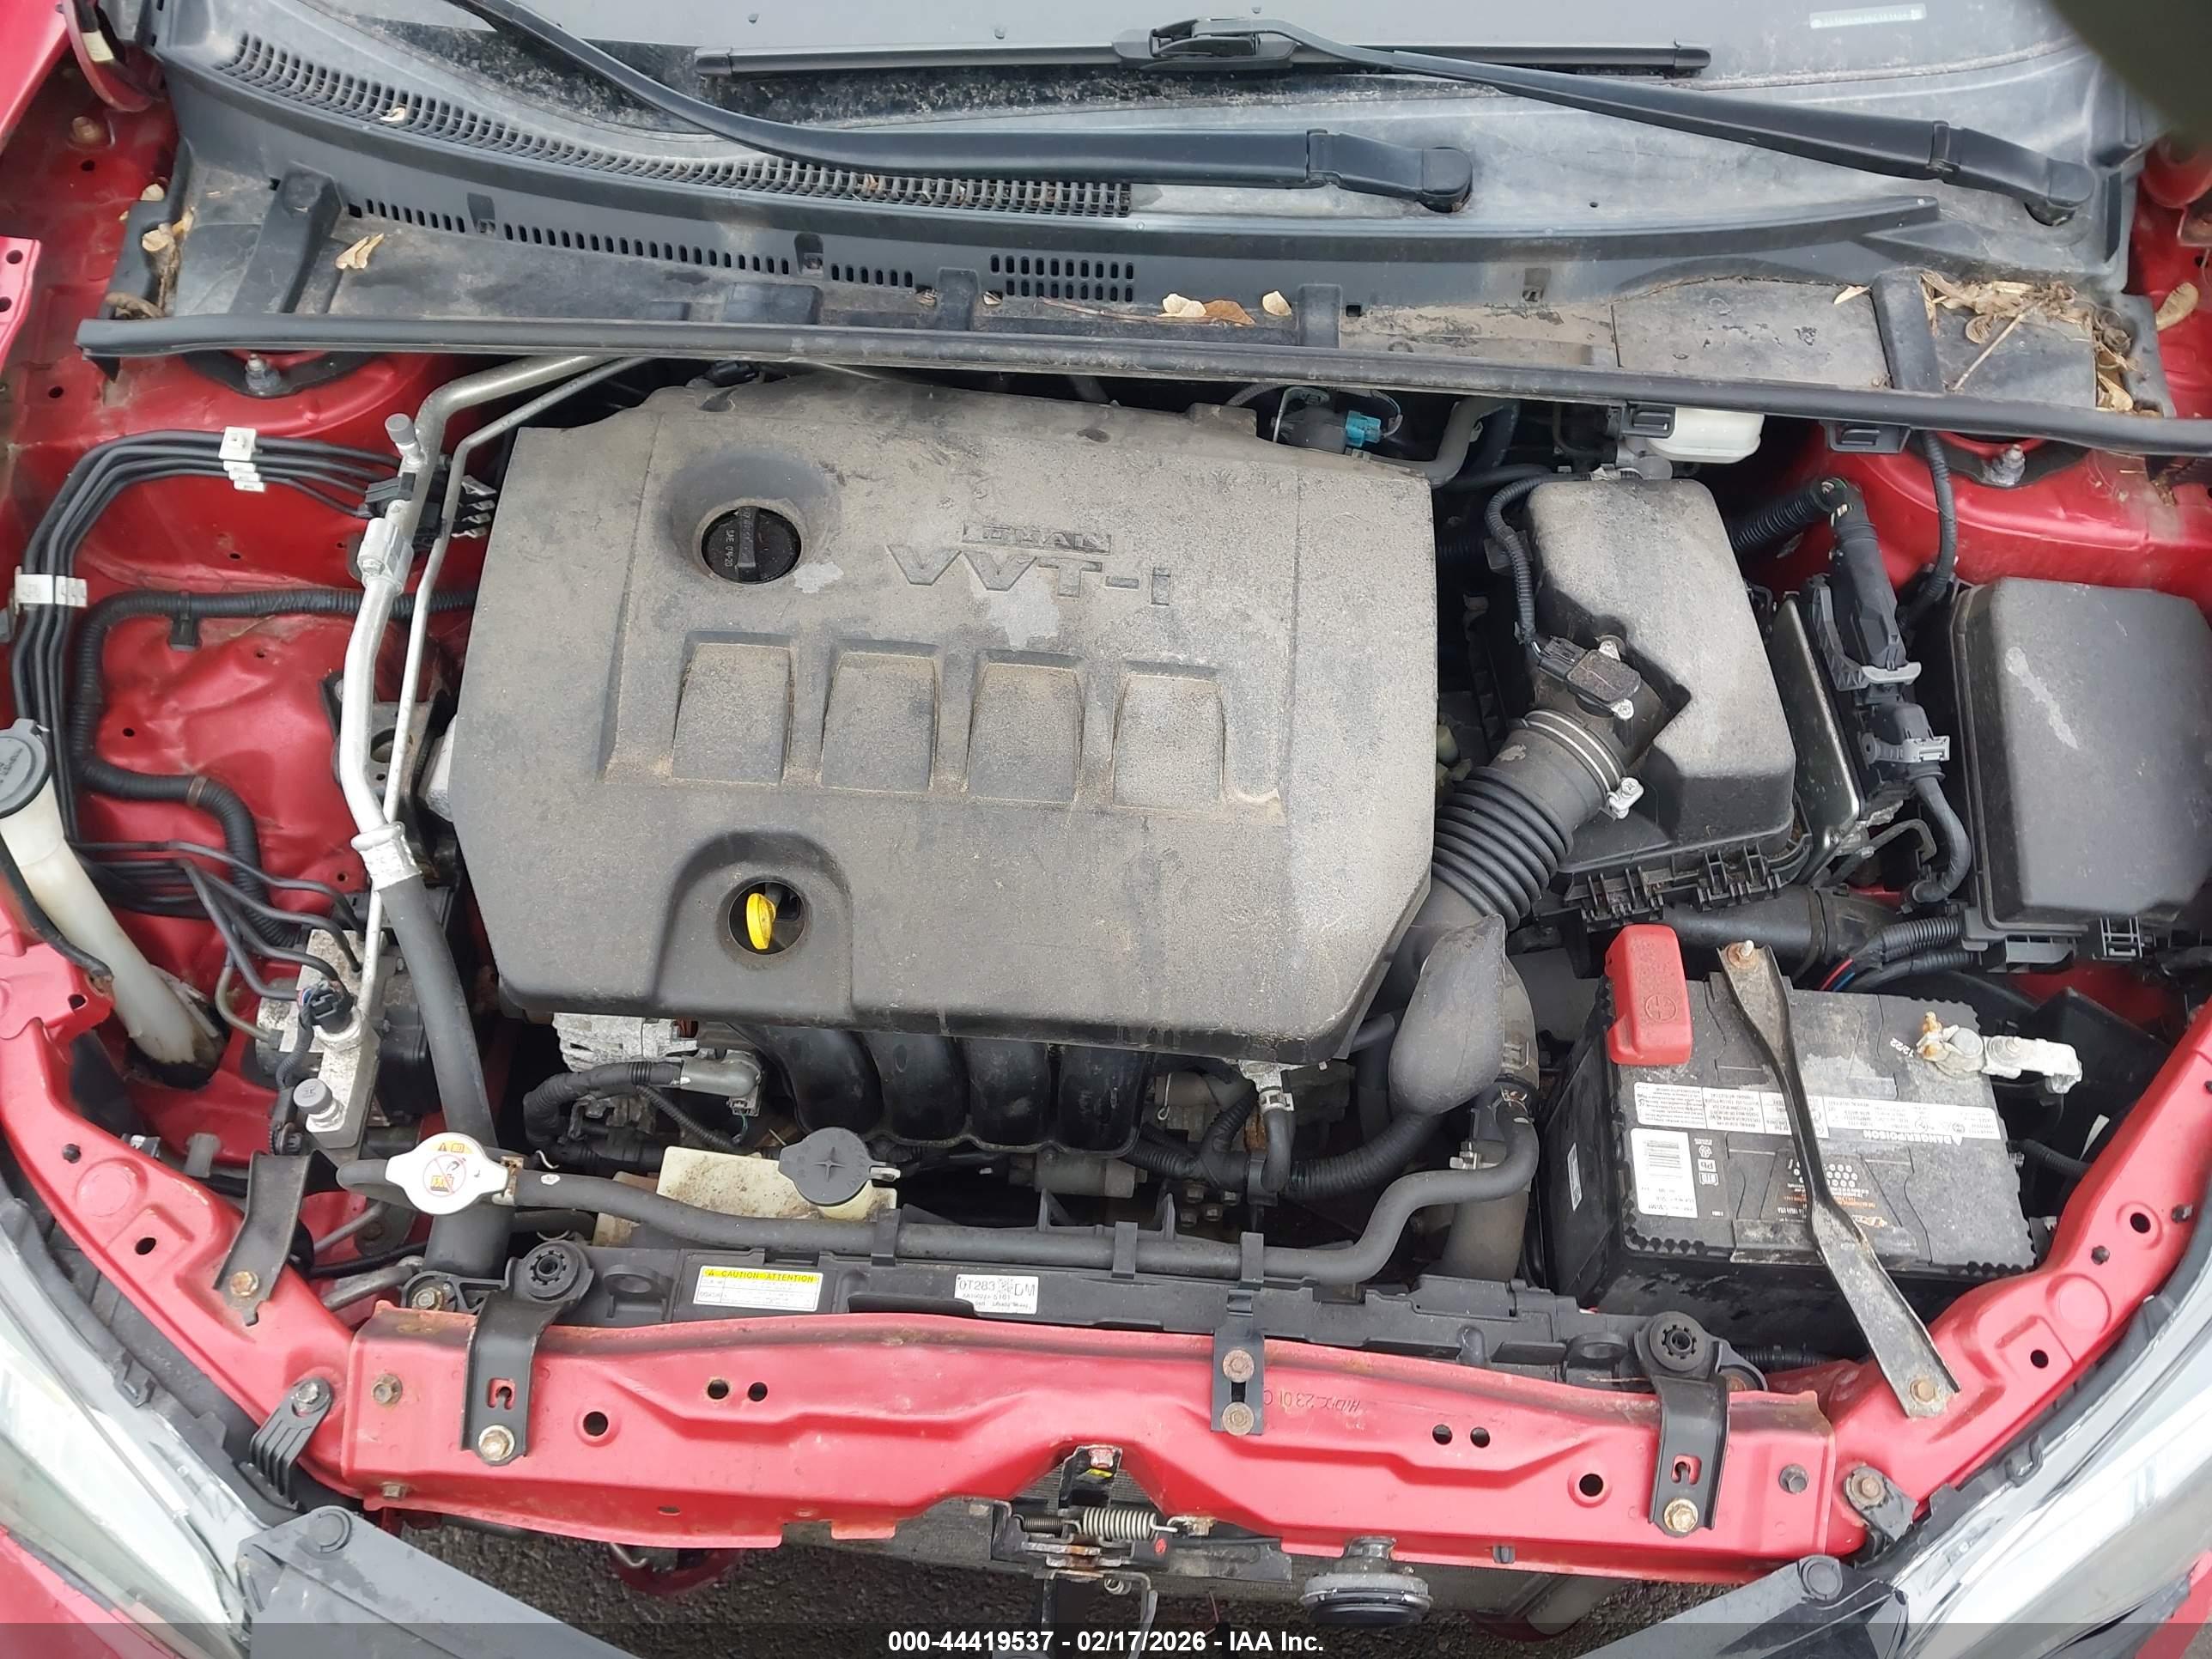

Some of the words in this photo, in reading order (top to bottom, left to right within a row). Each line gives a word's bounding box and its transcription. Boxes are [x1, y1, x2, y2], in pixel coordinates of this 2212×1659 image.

[725, 529, 735, 543] SAE
[721, 1270, 760, 1279] CAUTION
[767, 1273, 815, 1284] ATTENTION
[1013, 1282, 1036, 1297] DM
